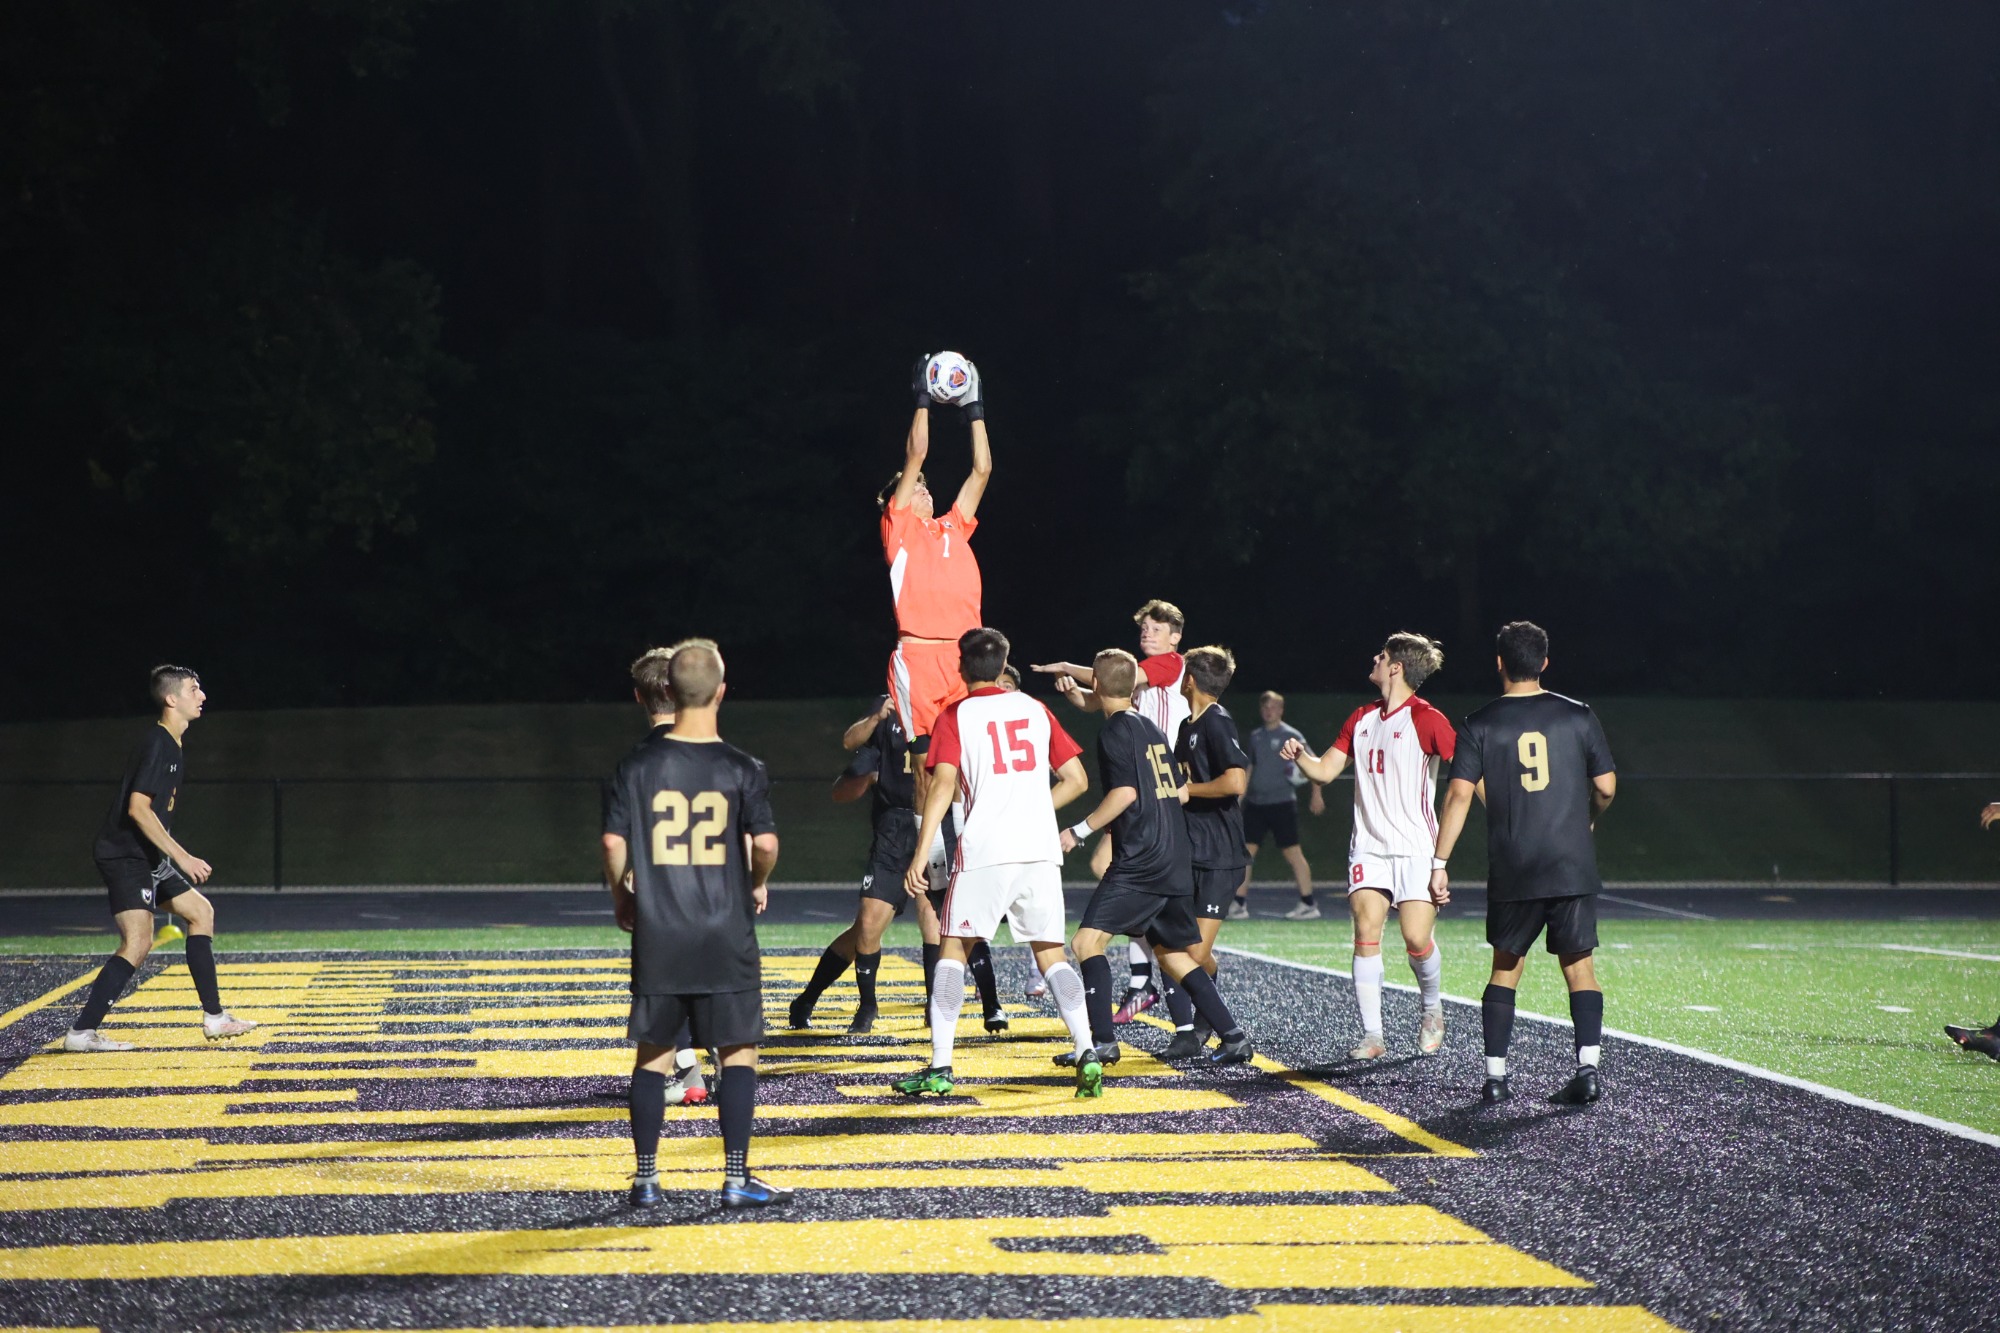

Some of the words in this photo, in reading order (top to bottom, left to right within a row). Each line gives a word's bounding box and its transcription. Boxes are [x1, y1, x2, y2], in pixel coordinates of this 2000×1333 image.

[942, 533, 950, 558] 1
[986, 718, 1037, 775] 15
[1145, 743, 1179, 800] 15
[1368, 748, 1385, 774] 18
[1518, 731, 1549, 792] 9
[651, 789, 729, 866] 22
